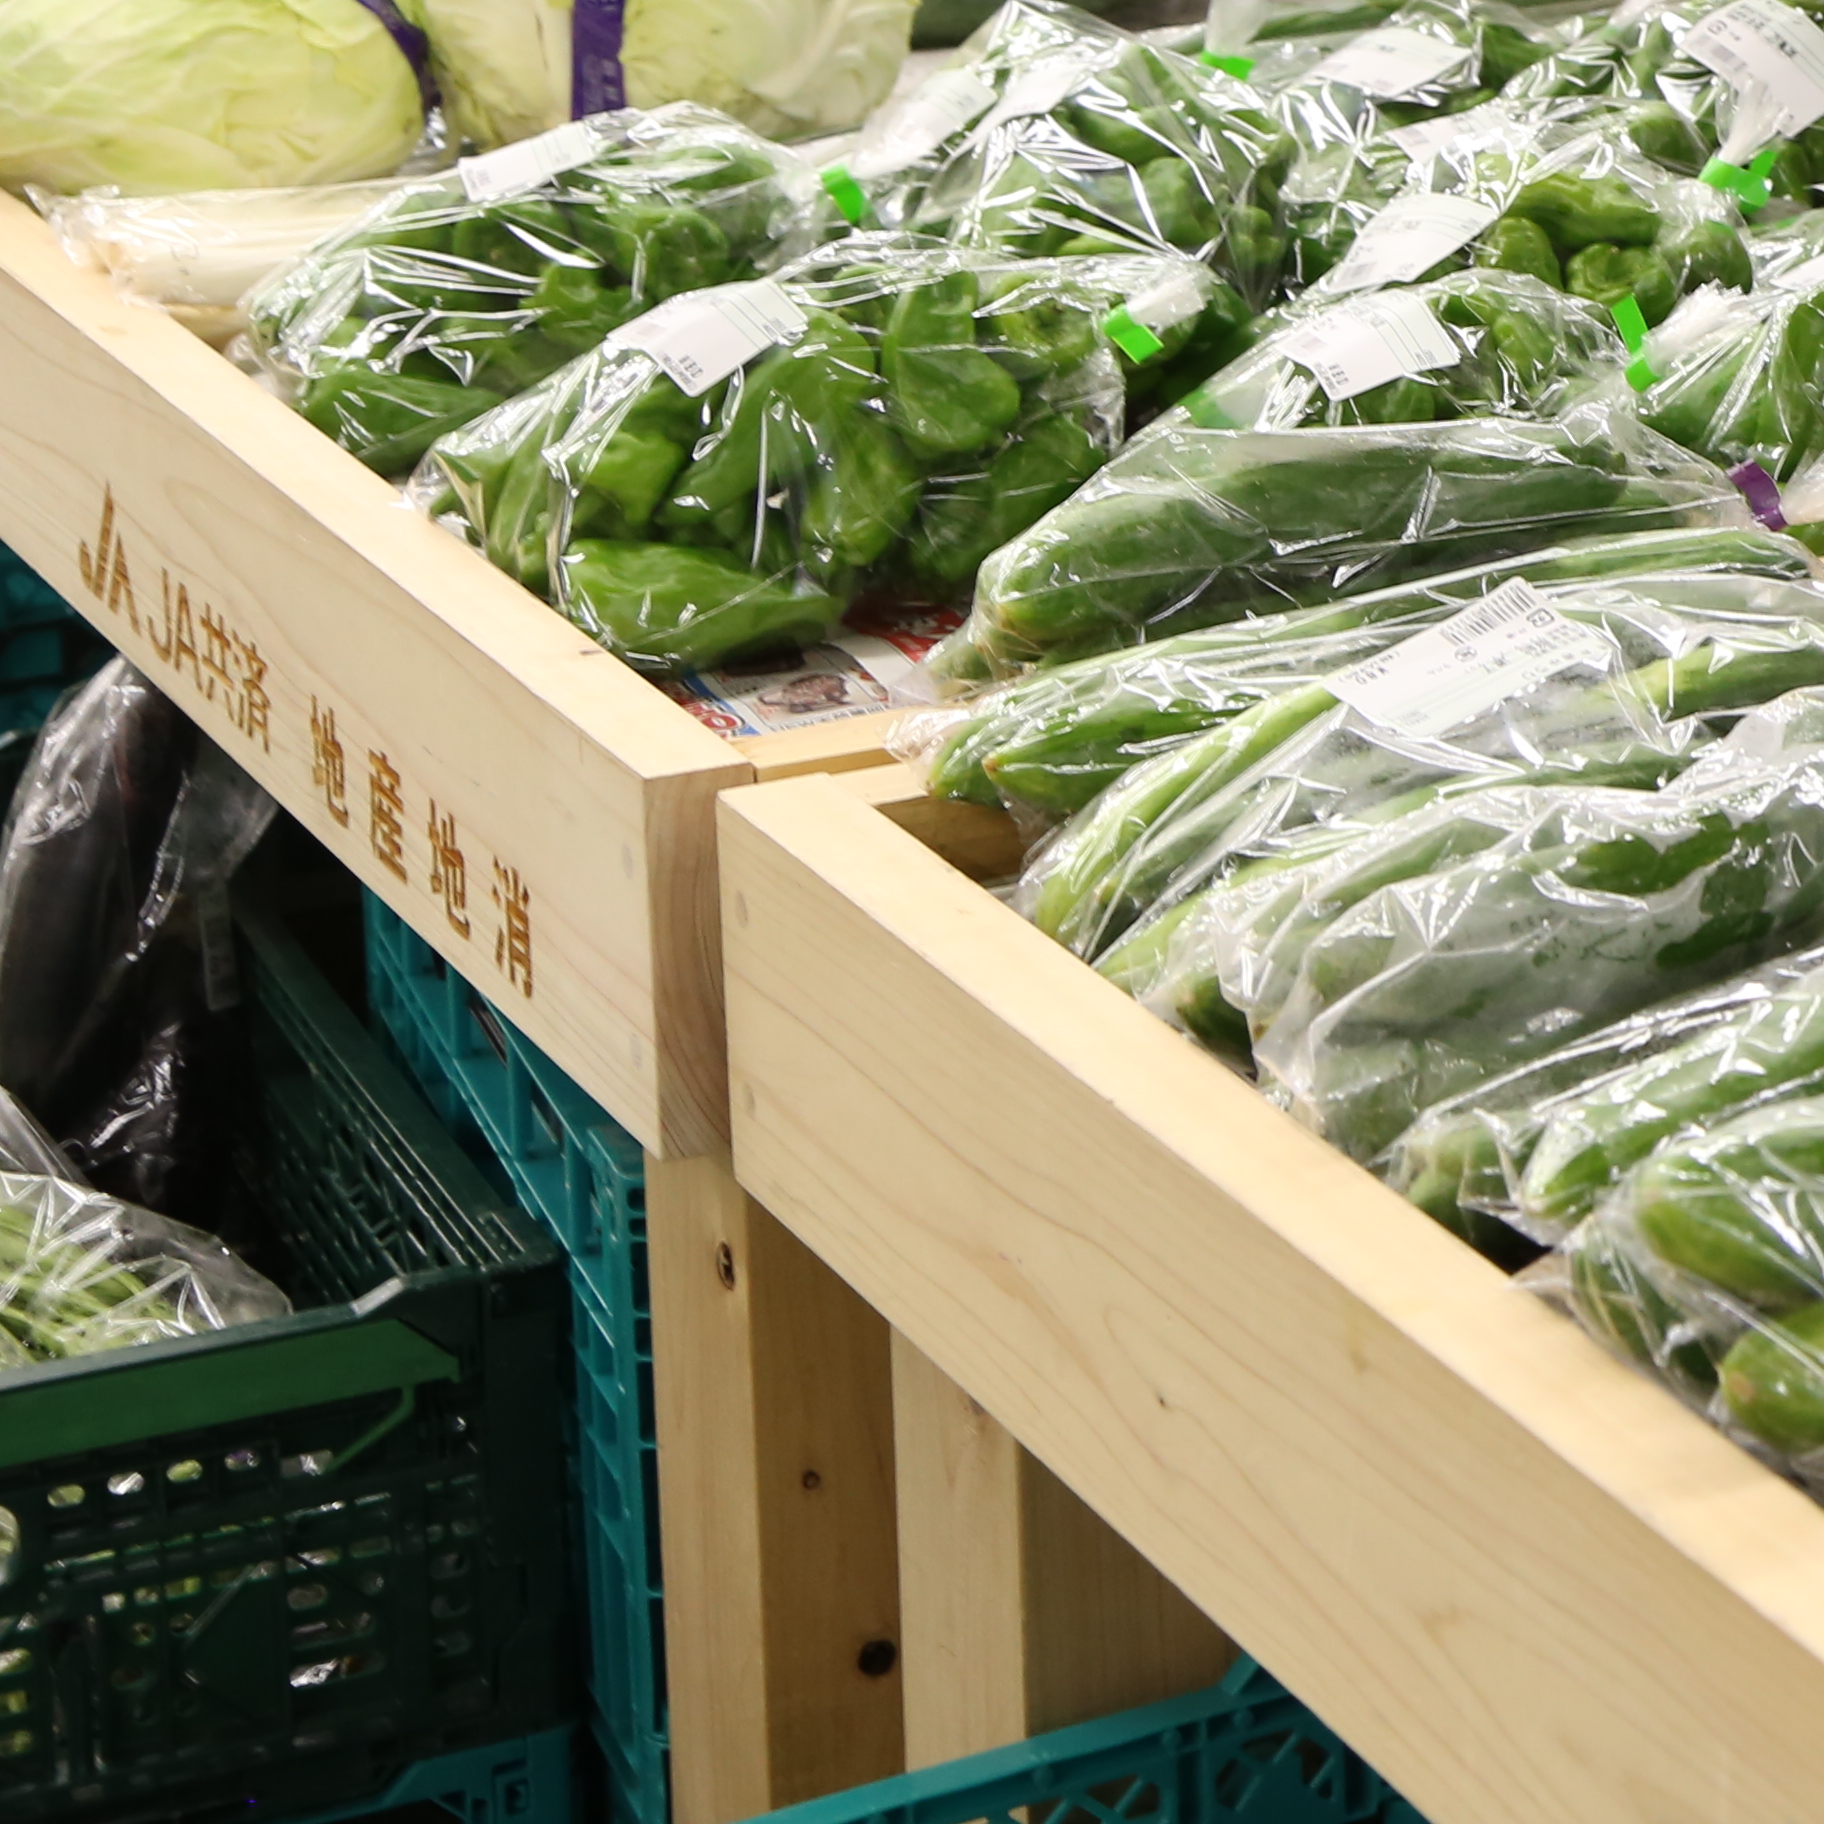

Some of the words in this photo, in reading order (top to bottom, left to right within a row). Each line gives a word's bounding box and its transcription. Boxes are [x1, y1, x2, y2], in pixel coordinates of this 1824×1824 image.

[147, 567, 272, 755] JA共済
[310, 693, 534, 1000] 地産地消
